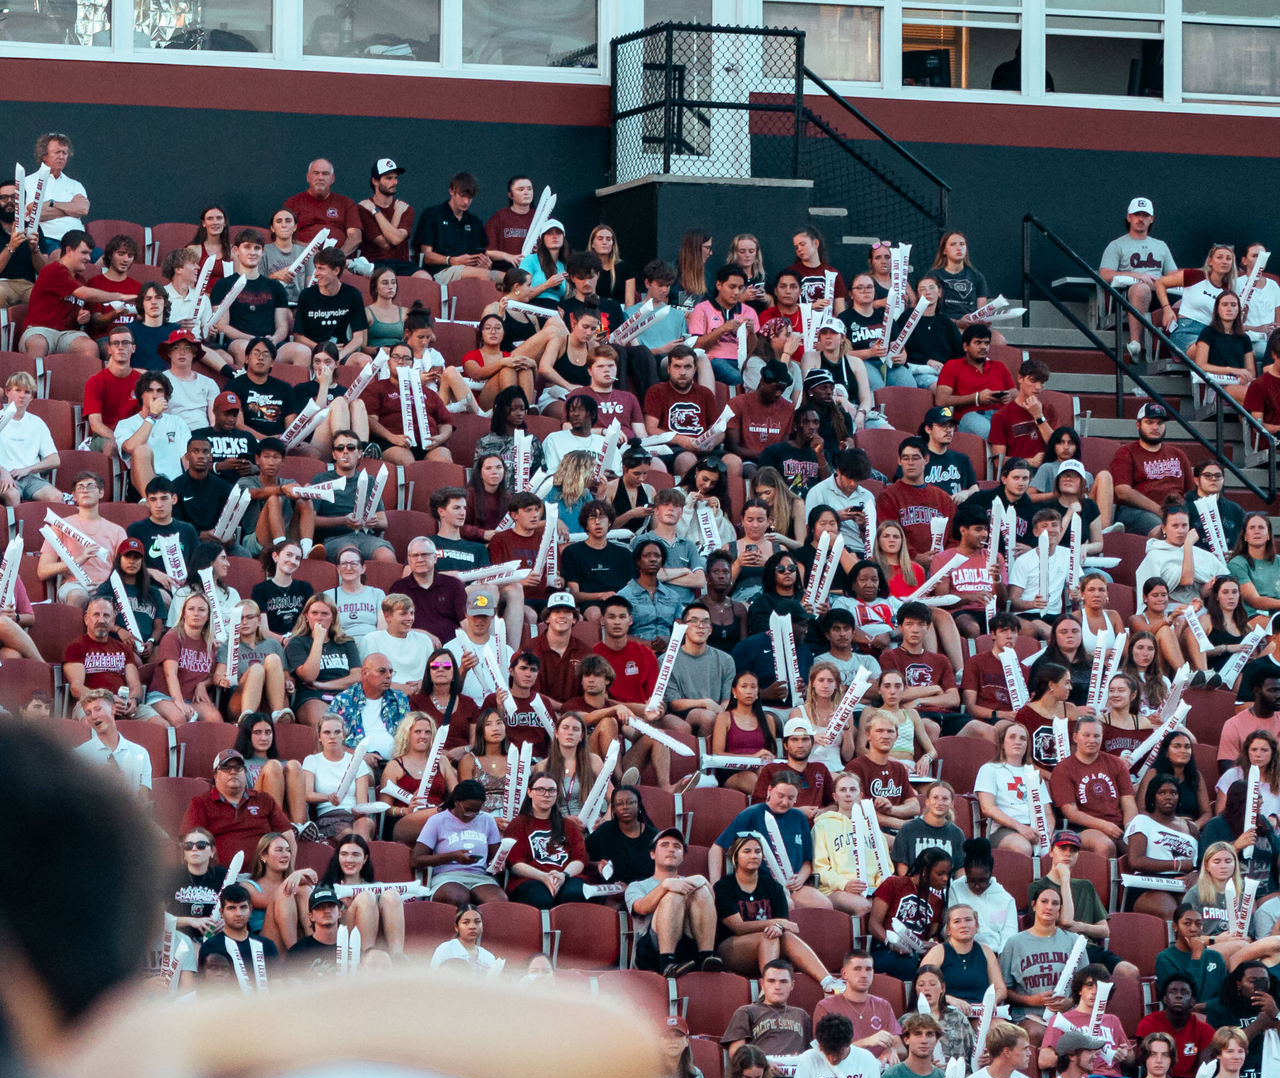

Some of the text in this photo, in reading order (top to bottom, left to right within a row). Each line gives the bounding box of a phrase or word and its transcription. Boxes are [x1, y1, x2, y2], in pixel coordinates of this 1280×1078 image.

[293, 240, 323, 276] ON NEXT FALL
[891, 309, 919, 354] LIVE ON NEXT FALL
[404, 393, 411, 401] ON
[524, 468, 528, 476] ON
[925, 466, 961, 483] Mets
[702, 511, 710, 525] FALL
[899, 507, 940, 526] GAMECOCK
[53, 519, 91, 548] LIVE ON NEXT FA
[704, 527, 713, 541] NEXT
[952, 568, 992, 584] CAROLIN
[956, 584, 992, 592] GAMECOCKS
[338, 602, 375, 613] AROLINA
[653, 638, 679, 698] LIVE ON NEXT FALL
[1005, 664, 1013, 677] LIVE
[1093, 662, 1099, 671] ON
[1008, 678, 1015, 687] ON
[1090, 673, 1098, 690] NEXT
[1010, 688, 1019, 703] NEXT
[1088, 692, 1096, 707] FALL
[826, 694, 861, 746] LIVE ON NEXT FALL
[431, 759, 441, 776] NEXT
[427, 777, 435, 787] ON
[505, 778, 510, 786] ON
[517, 777, 523, 786] ON
[397, 788, 410, 798] LIVE
[423, 788, 432, 802] LIVE
[1031, 789, 1048, 849] LIVE ON NEXT FALL
[1243, 893, 1252, 907] FALL
[1239, 908, 1248, 922] NEXT
[1023, 973, 1063, 990] FOOTBA
[1098, 999, 1106, 1013] LIVE
[1095, 1014, 1102, 1023] ON
